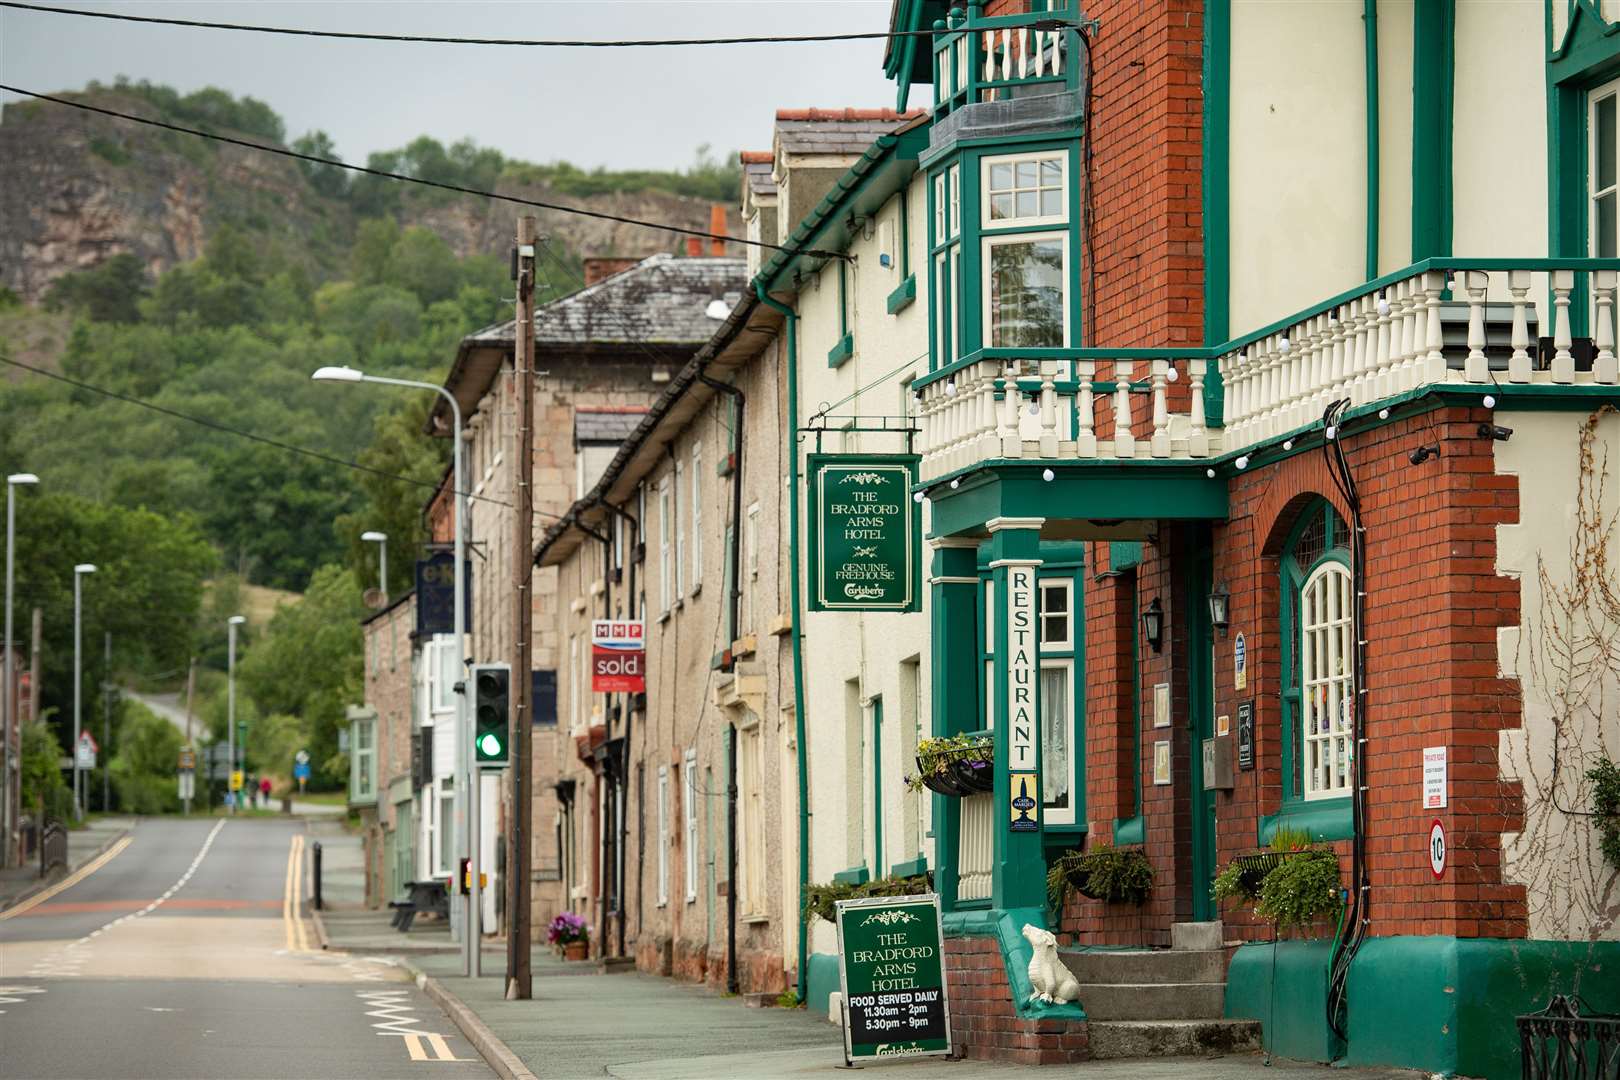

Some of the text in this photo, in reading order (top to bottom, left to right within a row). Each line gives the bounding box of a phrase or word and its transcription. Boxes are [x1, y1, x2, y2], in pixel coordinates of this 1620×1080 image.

[852, 491, 878, 502] THE
[831, 504, 899, 515] BRADFORD
[846, 517, 884, 527] ARMS
[844, 529, 886, 540] HOTEL
[842, 563, 888, 572] GENUINE
[835, 571, 895, 580] FREEHOUSE
[844, 583, 885, 600] Carlsberg
[597, 655, 637, 675] sold
[1013, 572, 1031, 761] RESTAURANT
[1432, 837, 1443, 860] 10
[877, 933, 907, 946] THE
[853, 946, 933, 963] BRADFORD
[873, 963, 917, 976] ARMS
[872, 978, 920, 992] HOTEL
[850, 991, 938, 1007] FOOD SERVED DAILY
[864, 1005, 899, 1017] 11.30am
[908, 1003, 928, 1016] 2pm
[866, 1019, 900, 1030] 5.30pm
[909, 1016, 928, 1029] 9pm
